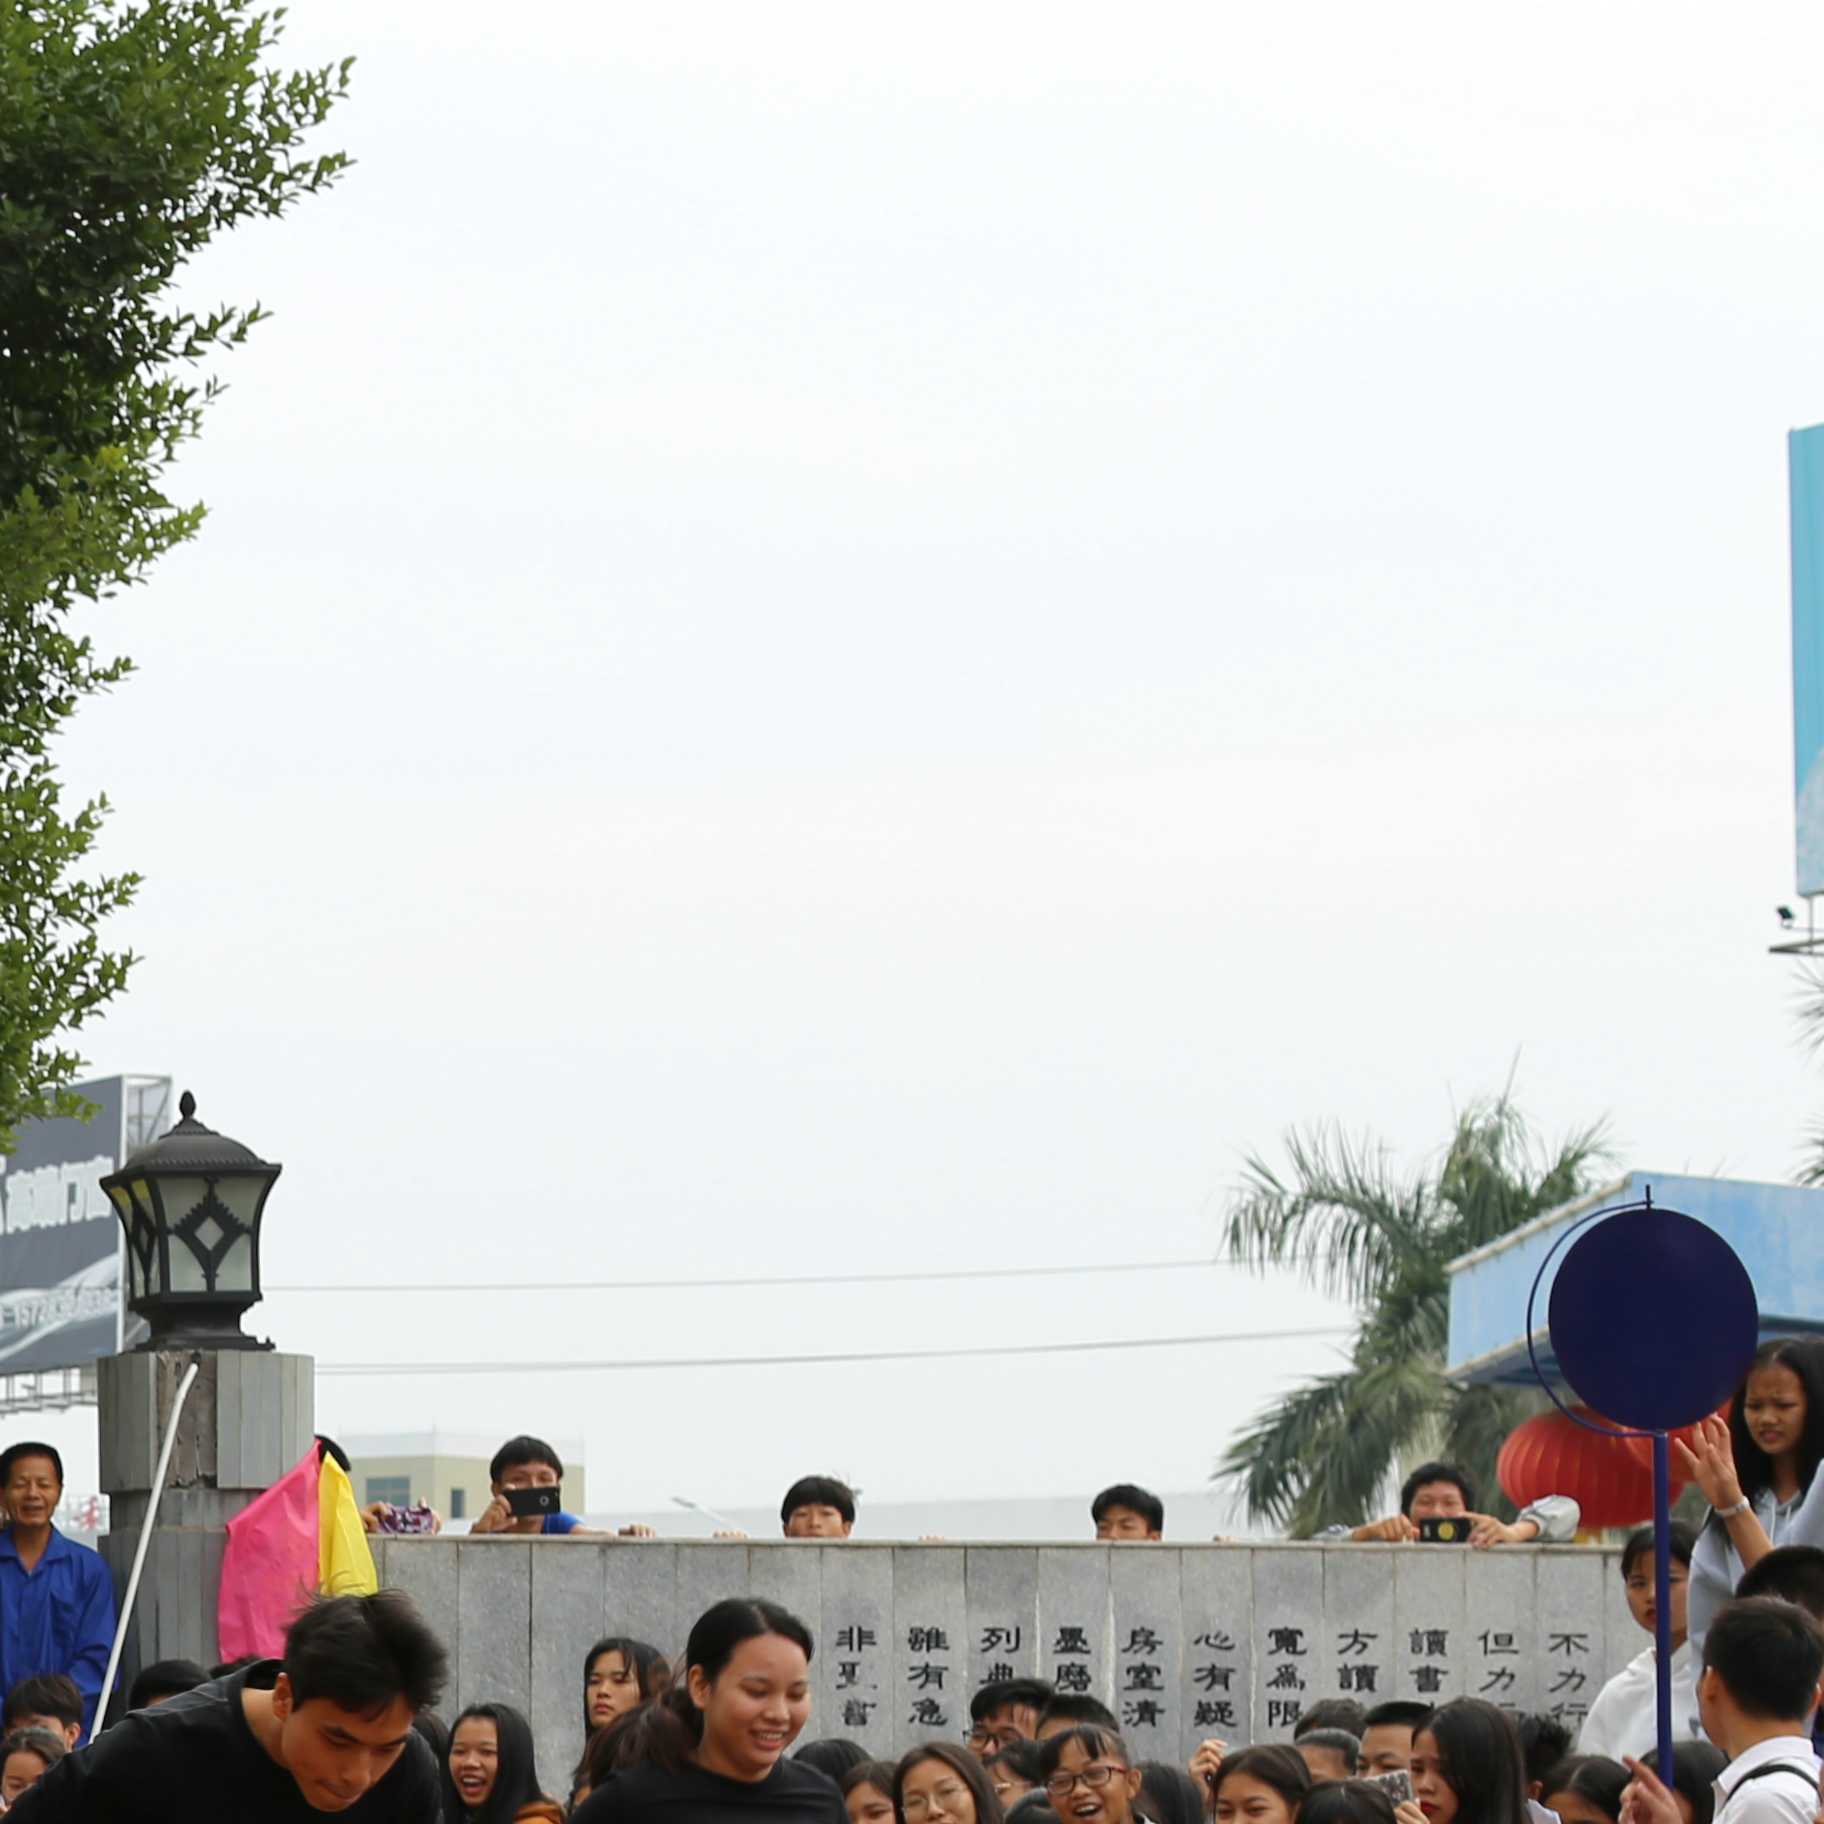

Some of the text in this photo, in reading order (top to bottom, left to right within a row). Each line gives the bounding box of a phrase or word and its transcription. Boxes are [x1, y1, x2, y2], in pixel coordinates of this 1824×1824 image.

[1122, 1627, 1165, 1728] 房室清
[1193, 1630, 1238, 1728] 心有疑
[1409, 1628, 1449, 1709] 讀書
[1478, 1629, 1520, 1709] 但力
